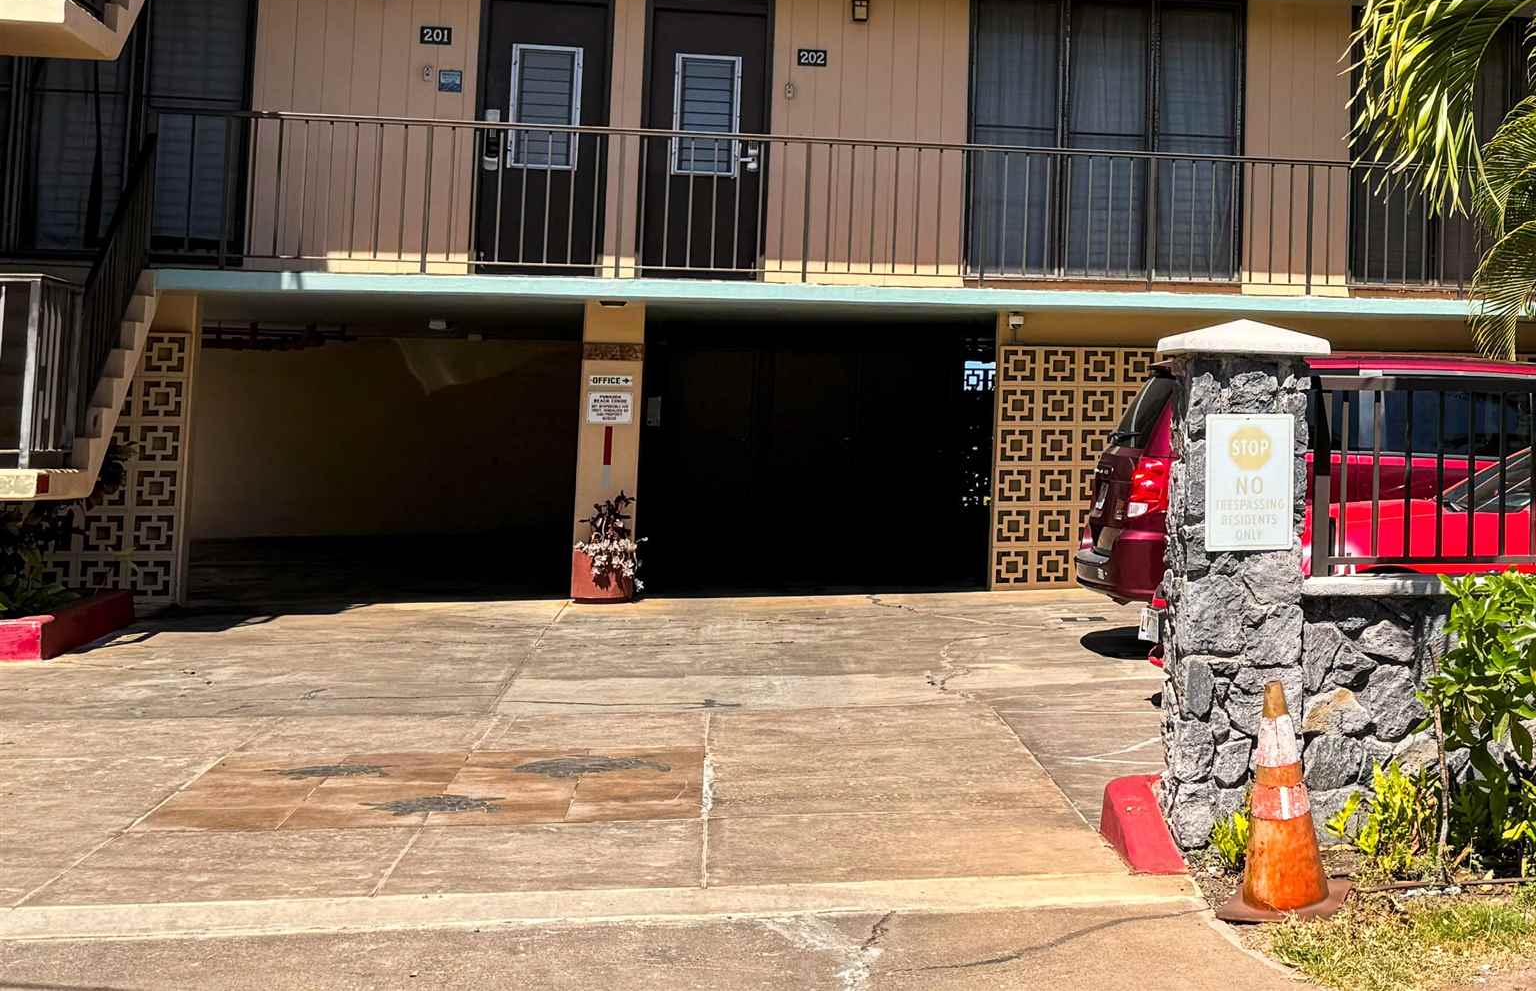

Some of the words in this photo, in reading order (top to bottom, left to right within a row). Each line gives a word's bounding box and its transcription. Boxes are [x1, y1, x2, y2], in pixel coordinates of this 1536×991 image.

[423, 28, 449, 42] 201
[799, 51, 825, 64] 202
[592, 376, 621, 385] OFFICE
[1231, 440, 1269, 456] STOP
[1235, 475, 1264, 496] NO
[1215, 497, 1286, 511] TRESPASSING
[1220, 514, 1278, 526] RESIDENTS
[1234, 528, 1263, 541] ONLY
